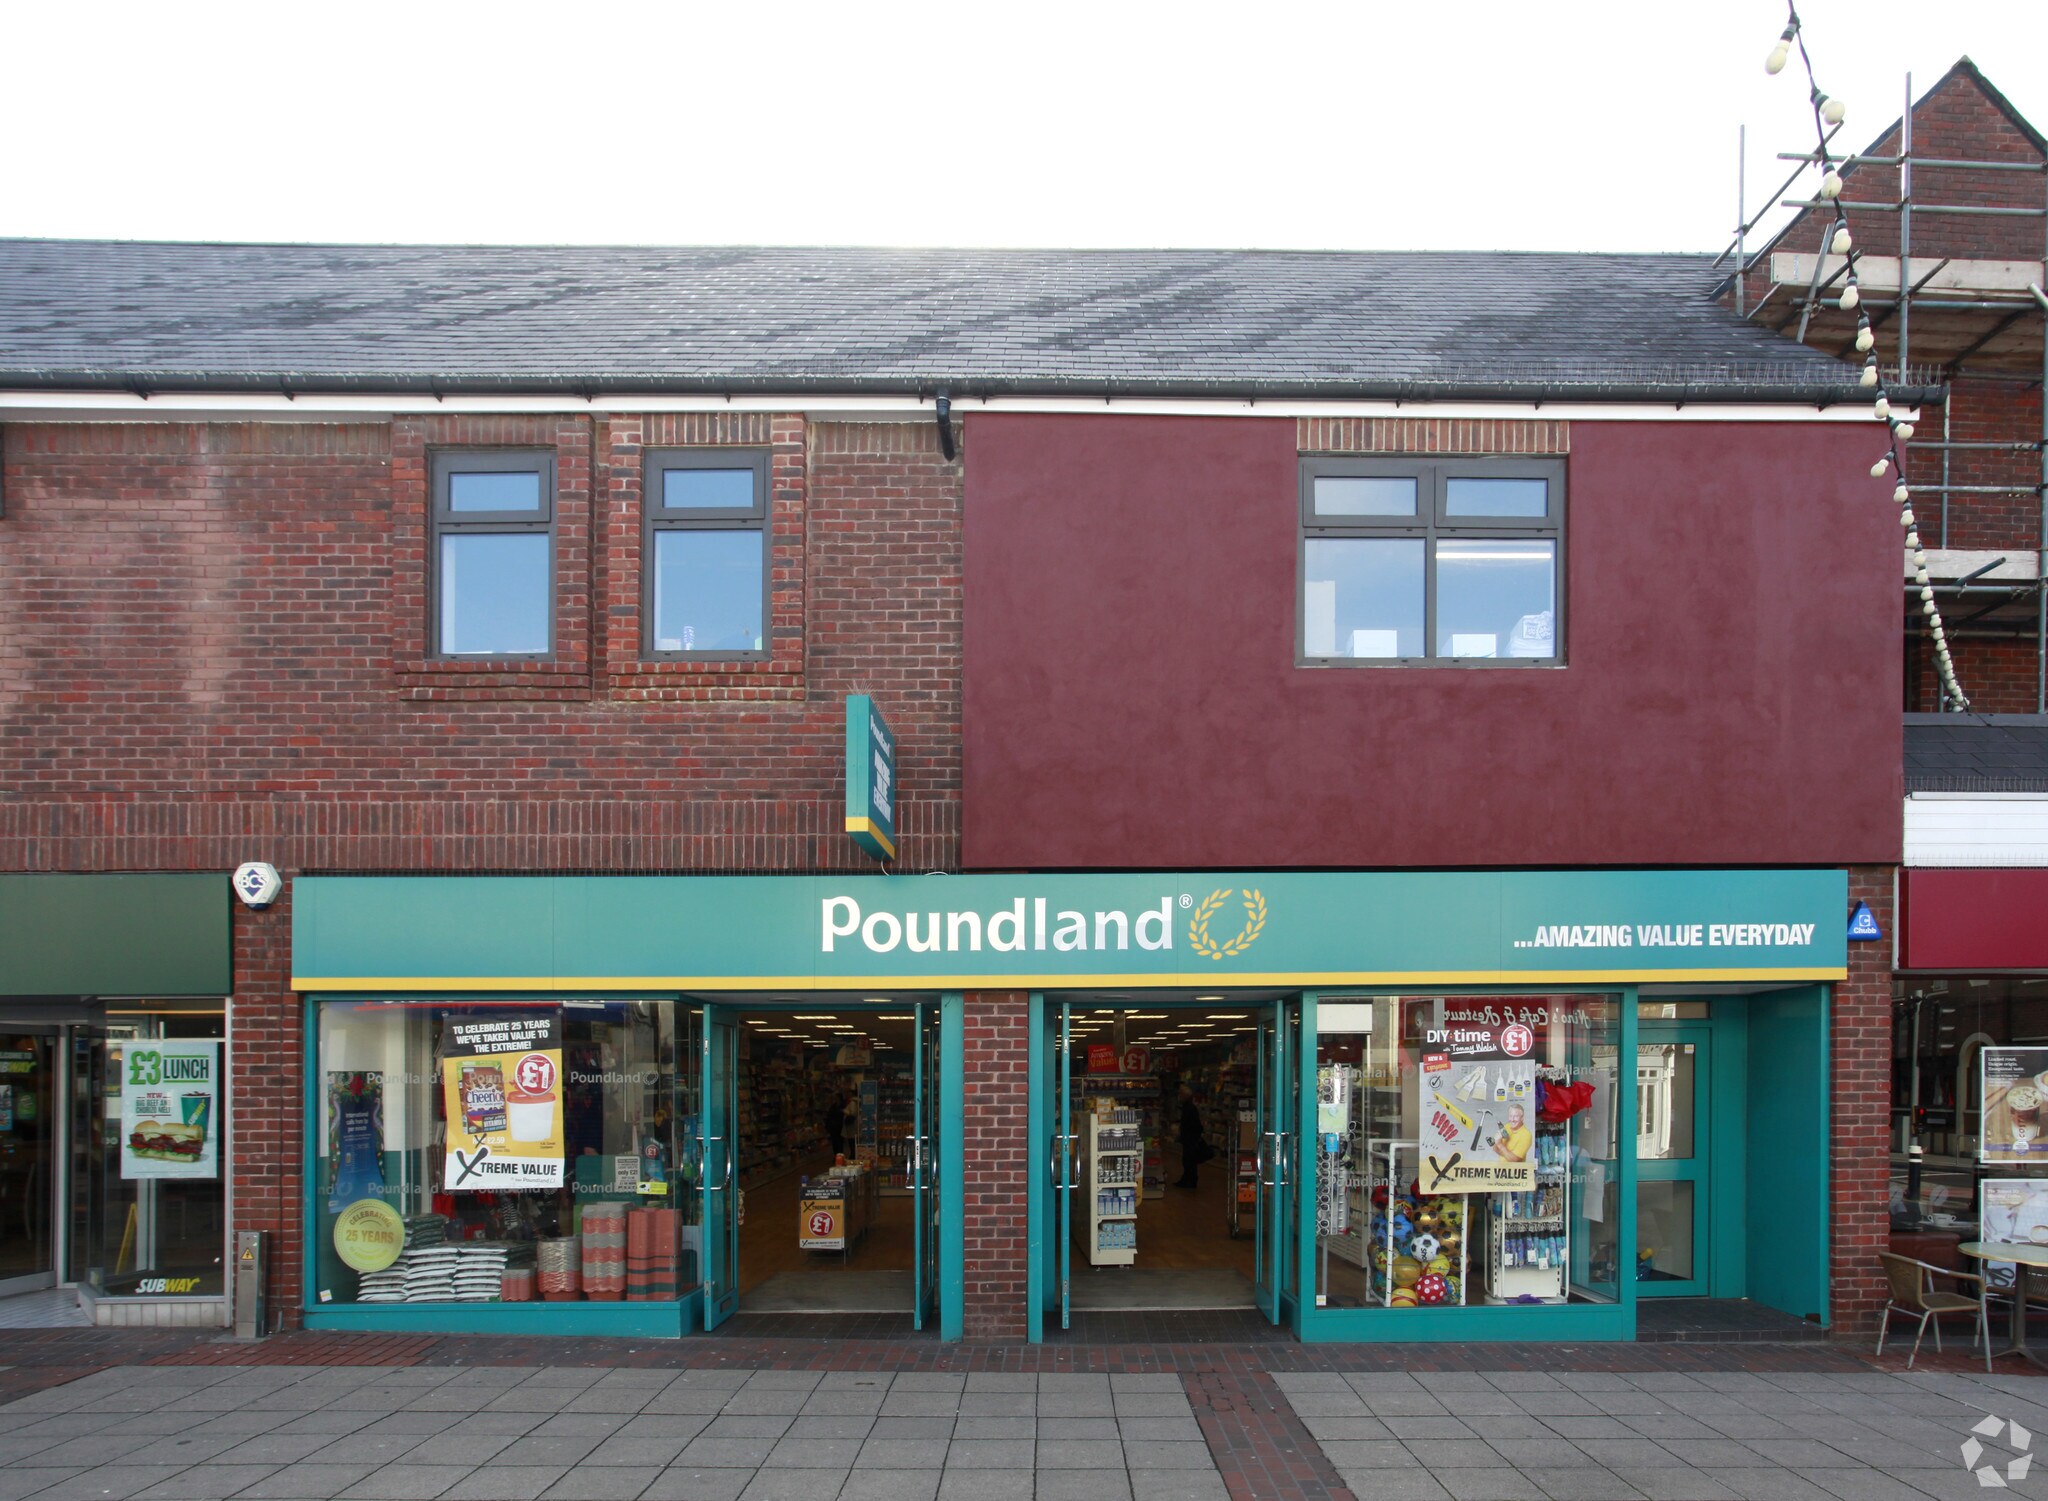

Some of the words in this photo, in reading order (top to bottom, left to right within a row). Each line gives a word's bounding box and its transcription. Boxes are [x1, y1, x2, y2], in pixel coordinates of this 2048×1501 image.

[239, 874, 266, 888] BCS
[821, 895, 1173, 953] Poundland
[1636, 923, 1703, 947] VALUE
[1708, 923, 1815, 946] EVERYDAY
[453, 1025, 464, 1035] TO
[465, 1022, 510, 1034] CELEBRATE
[511, 1021, 522, 1031] 25
[523, 1019, 551, 1030] YEARS
[456, 1034, 482, 1045] WE'VE
[482, 1032, 509, 1043] TAKEN
[510, 1030, 537, 1041] VALUE
[537, 1029, 549, 1039] TO
[1427, 1030, 1450, 1043] DIY
[1454, 1029, 1491, 1042] time
[1506, 1030, 1528, 1051] £1
[474, 1043, 490, 1053] THE
[491, 1041, 532, 1052] EXTREME!
[1450, 1043, 1475, 1054] Tommy
[129, 1051, 161, 1085] £3
[163, 1059, 209, 1079] LUNCH
[1127, 1053, 1146, 1070] £1
[521, 1061, 550, 1089] £1
[570, 1071, 640, 1083] Poundland
[466, 1090, 505, 1104] Cheerios
[521, 1163, 557, 1176] VALUE
[1494, 1167, 1528, 1180] VALUE
[368, 1182, 438, 1194] Poundlad
[813, 1216, 831, 1234] £1
[345, 1229, 359, 1243] 25
[361, 1230, 395, 1245] YEARS
[135, 1277, 200, 1294] SUBWAY
